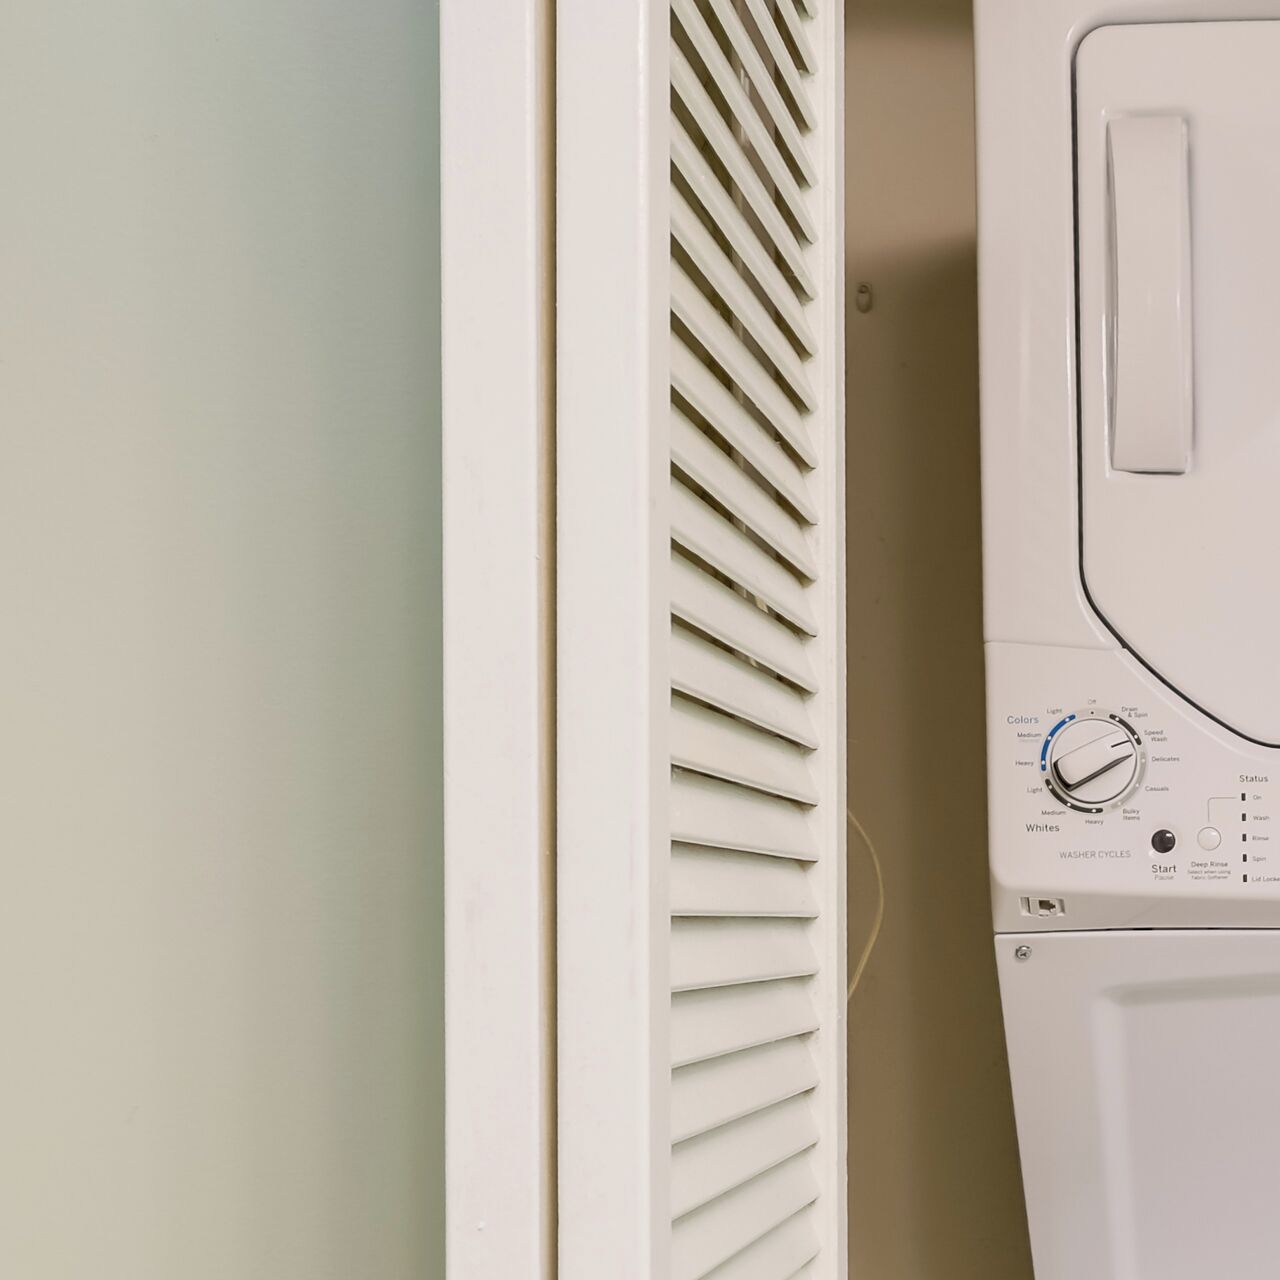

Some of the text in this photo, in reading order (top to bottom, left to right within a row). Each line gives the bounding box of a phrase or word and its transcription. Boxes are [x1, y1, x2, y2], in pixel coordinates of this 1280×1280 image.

[1007, 715, 1039, 724] Colors
[1144, 729, 1164, 737] Speed
[1025, 823, 1060, 832] Whites
[1059, 850, 1131, 859] WASHER CYCLES
[1151, 864, 1177, 873] Start
